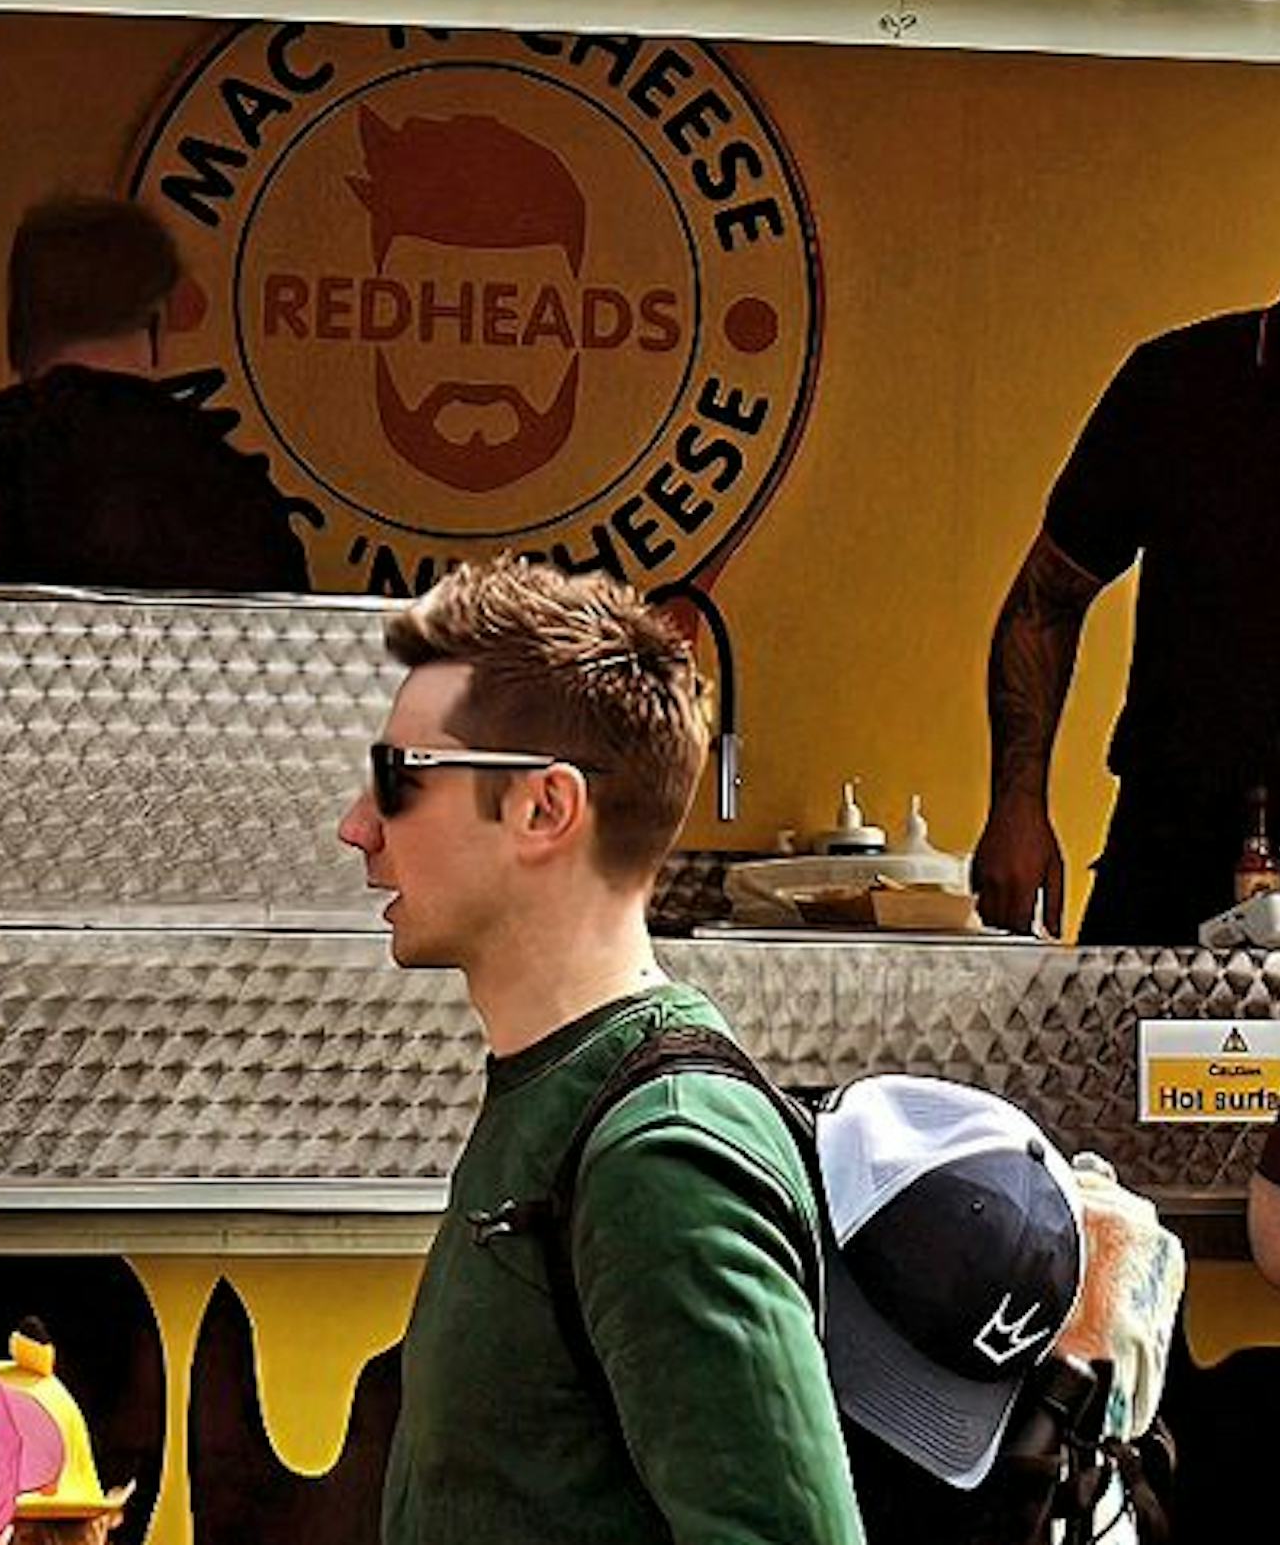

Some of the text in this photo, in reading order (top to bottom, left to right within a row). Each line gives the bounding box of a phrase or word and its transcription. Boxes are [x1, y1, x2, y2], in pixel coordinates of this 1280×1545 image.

[161, 26, 334, 227] MAC
[263, 274, 681, 352] REDHEADS
[1160, 1085, 1203, 1111] Hot
